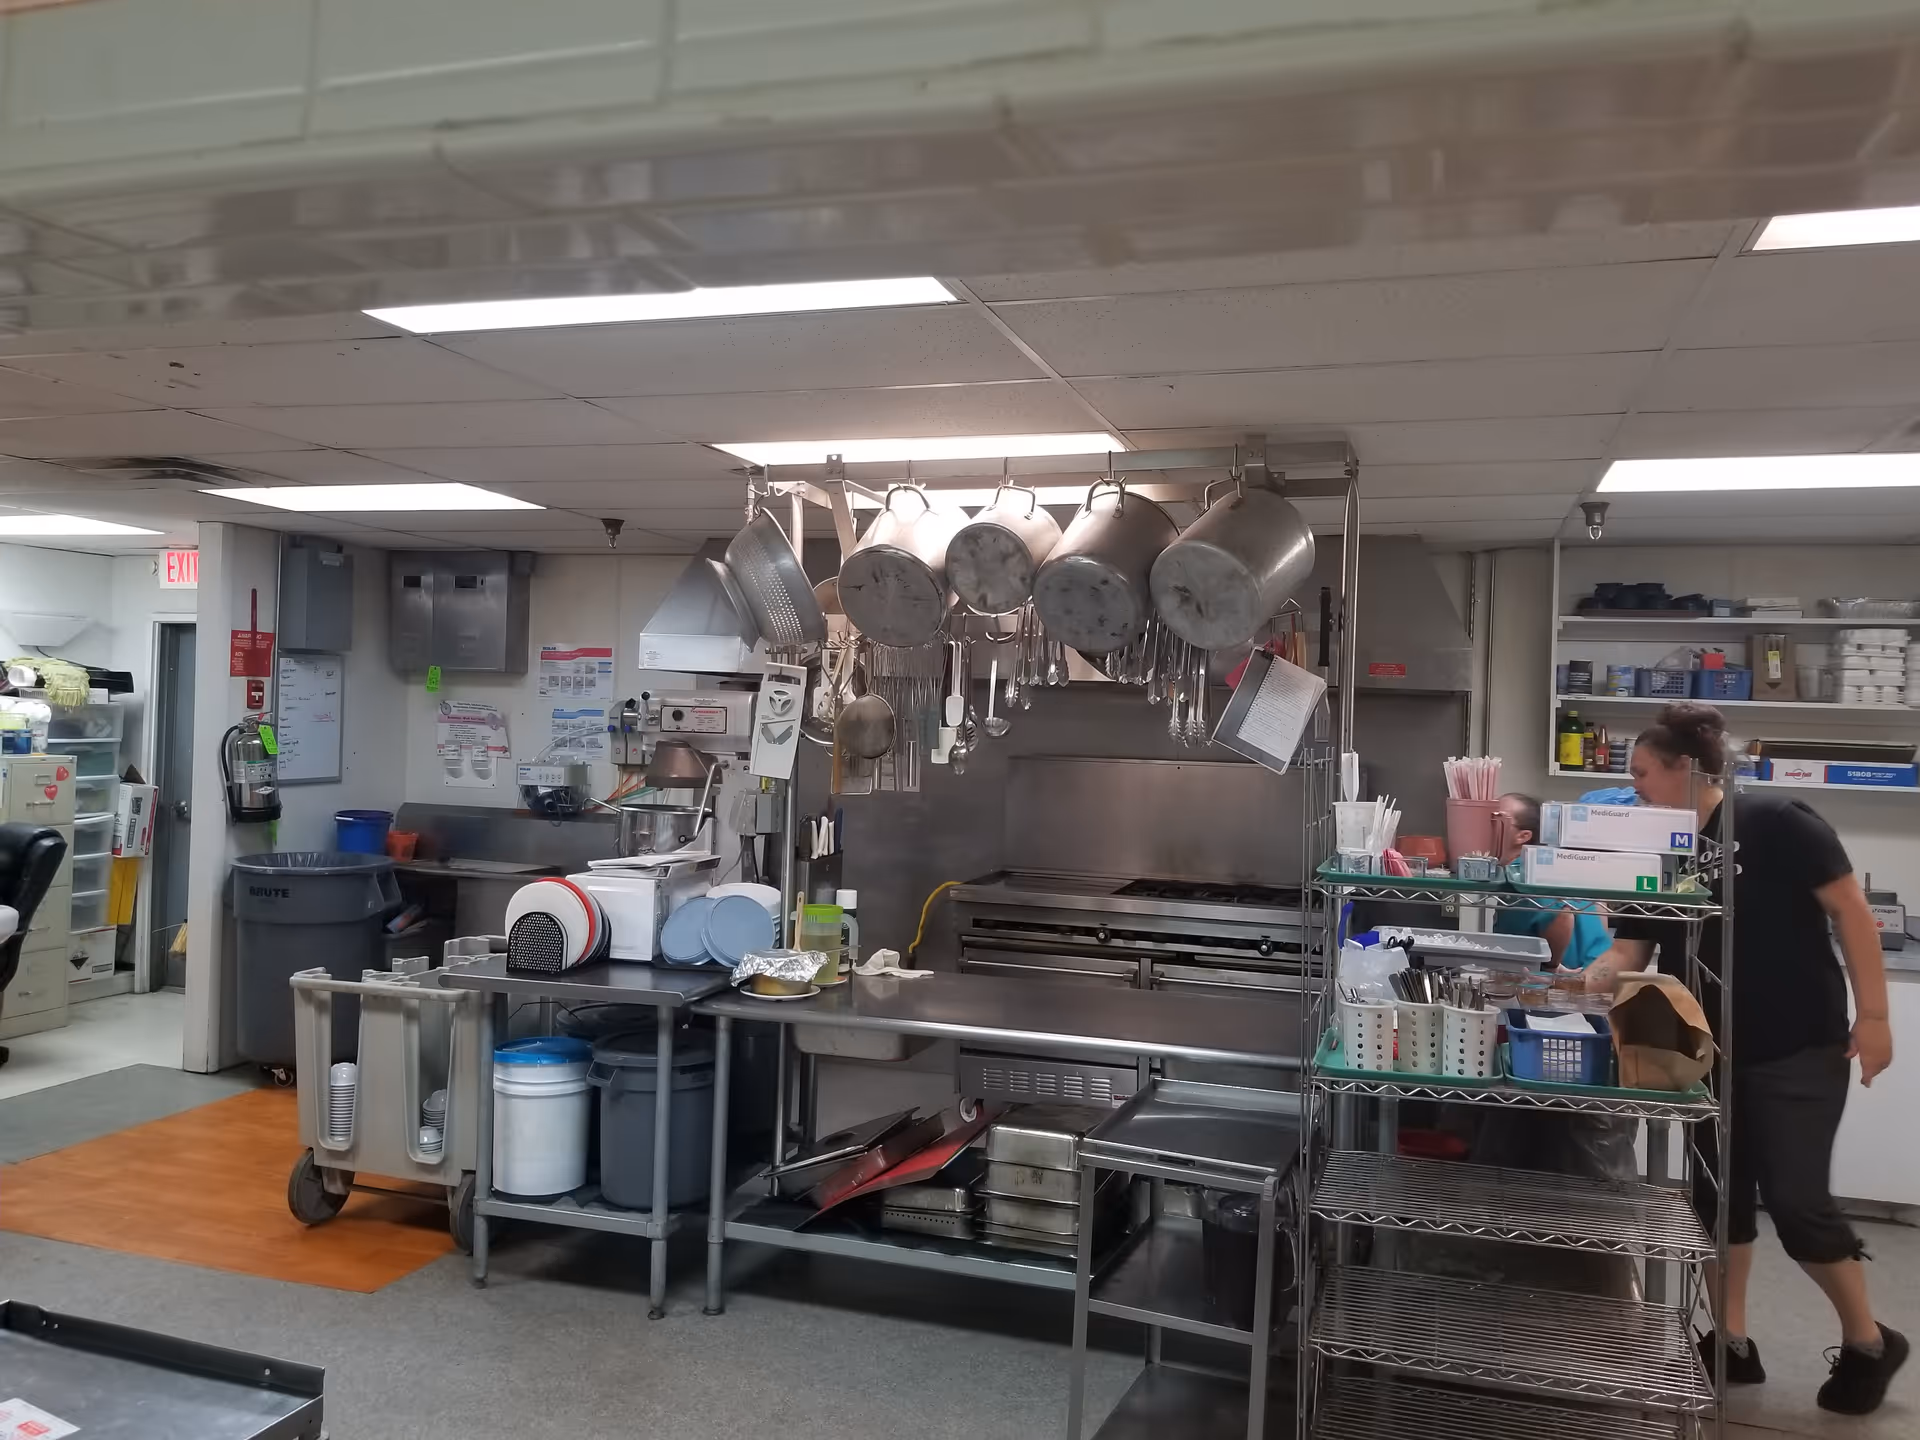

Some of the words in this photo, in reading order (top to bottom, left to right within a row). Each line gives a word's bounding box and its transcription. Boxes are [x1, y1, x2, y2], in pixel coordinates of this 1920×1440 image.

[166, 551, 199, 583] EXIT
[1591, 809, 1630, 818] MediGuard
[1675, 834, 1689, 847] M
[1556, 853, 1596, 862] MediGuard
[1643, 877, 1652, 890] L
